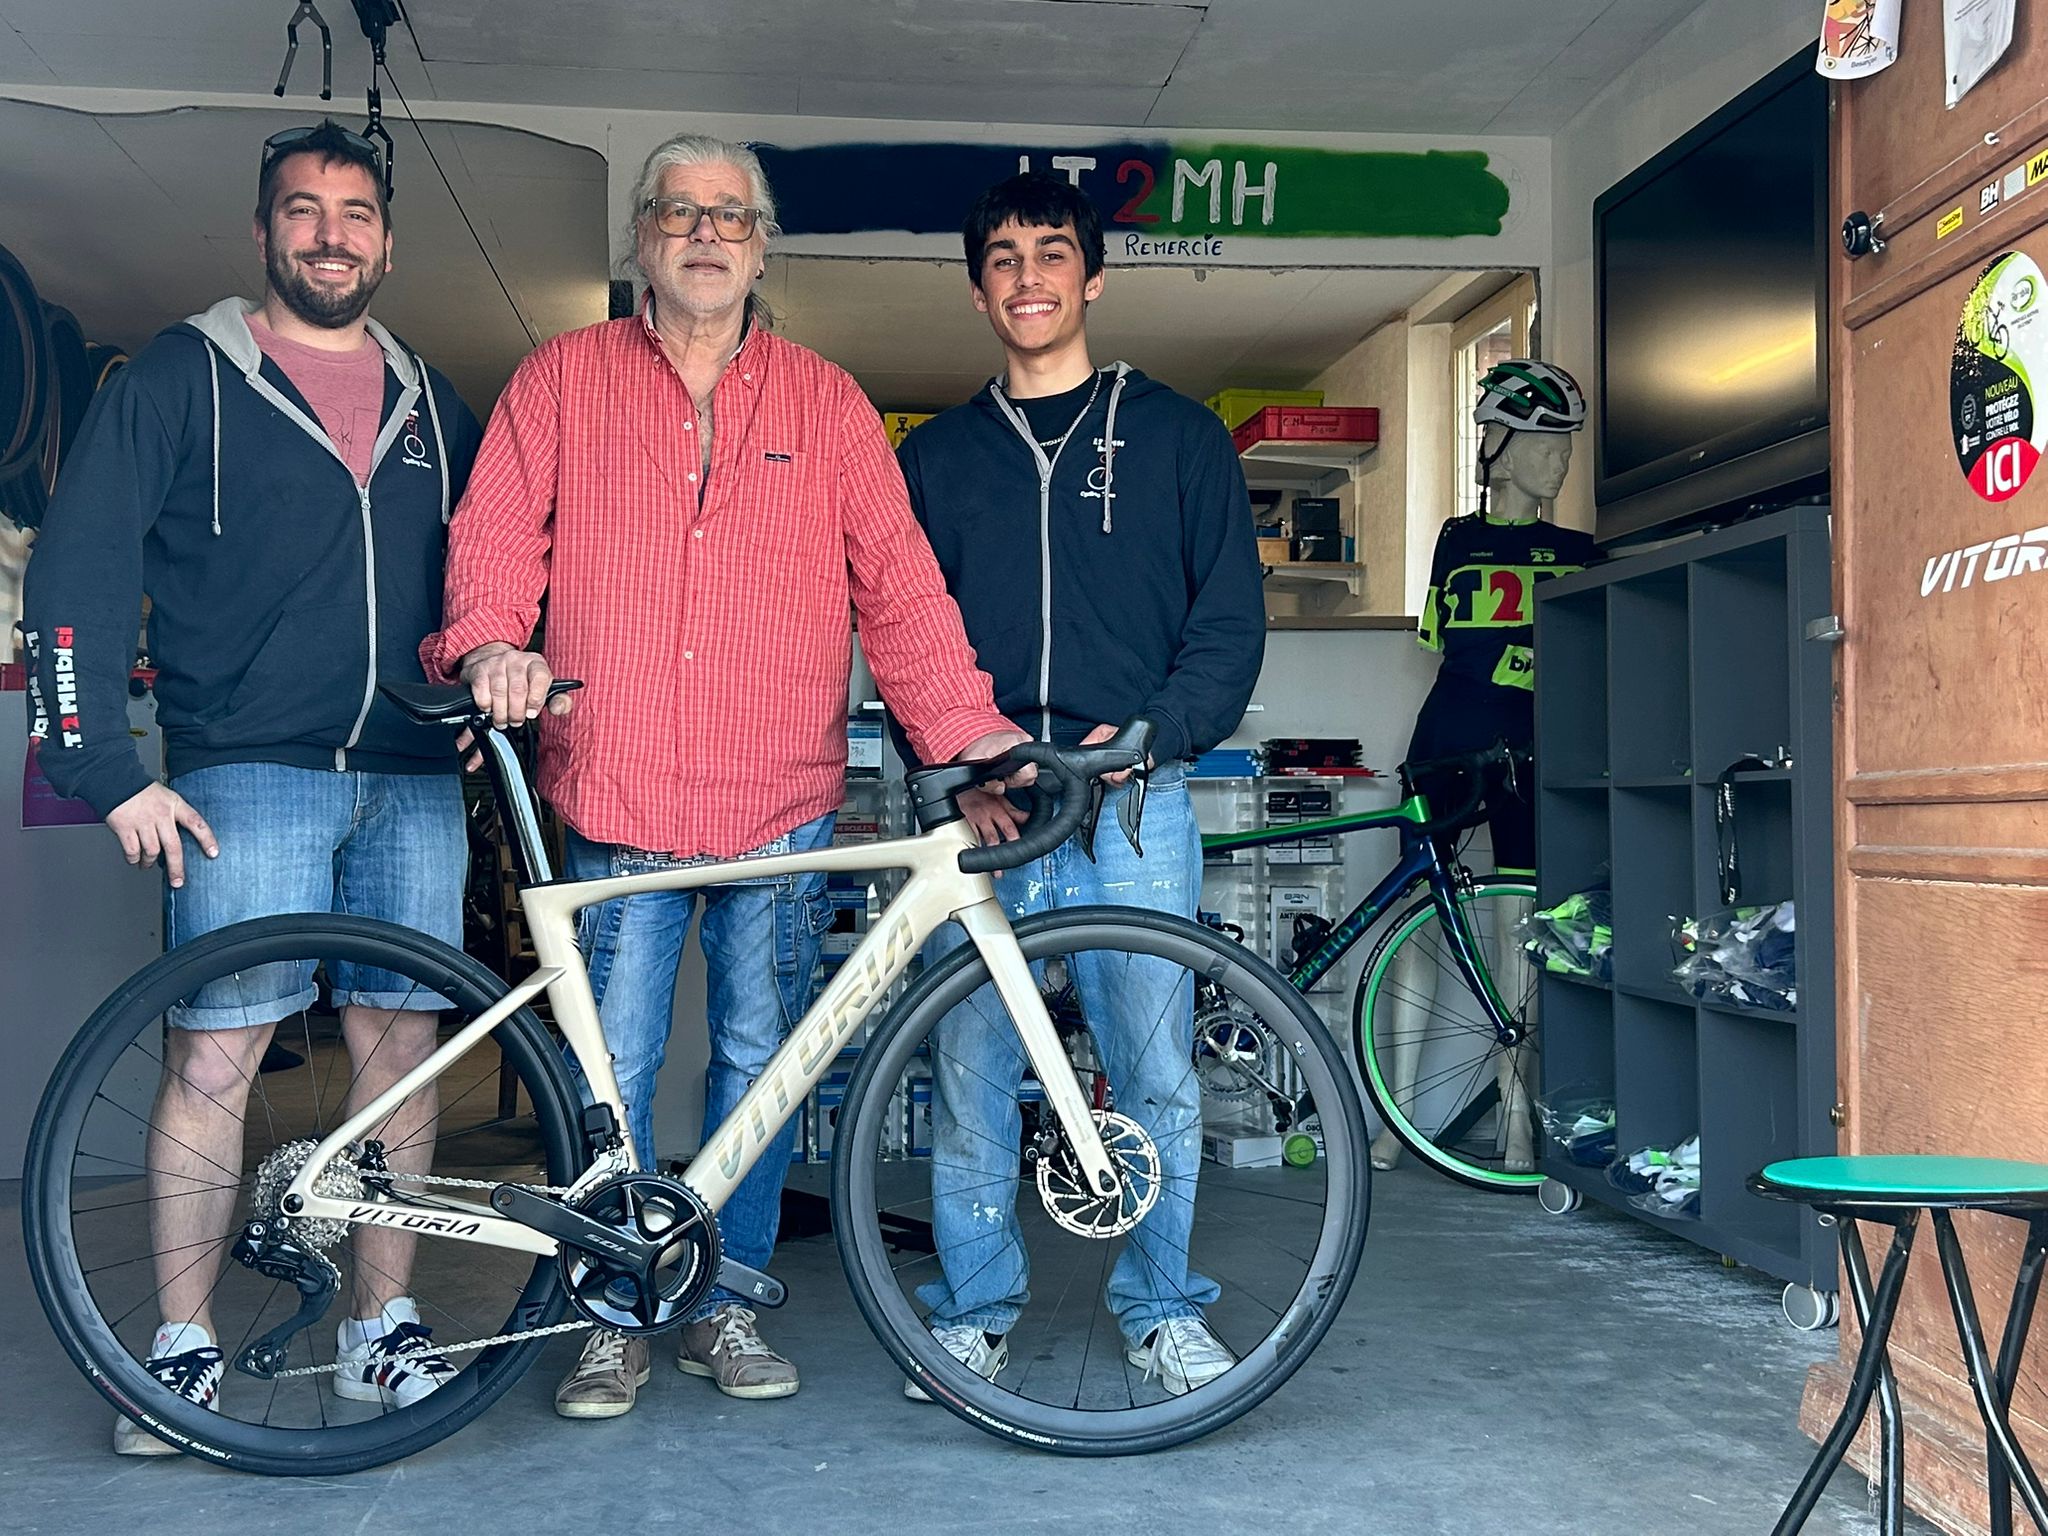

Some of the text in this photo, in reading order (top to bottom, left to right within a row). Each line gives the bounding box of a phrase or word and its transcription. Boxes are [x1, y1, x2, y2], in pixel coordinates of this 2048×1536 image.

[1981, 180, 1999, 209] BH
[1985, 376, 2018, 399] NOUVEAU
[1985, 393, 2019, 417] PROTÉGEZ
[1986, 441, 2021, 496] ICI
[1920, 525, 2048, 597] VITOR
[717, 912, 914, 1180] VITORIA
[348, 1206, 481, 1236] VITORIA
[140, 1413, 157, 1427] PRO
